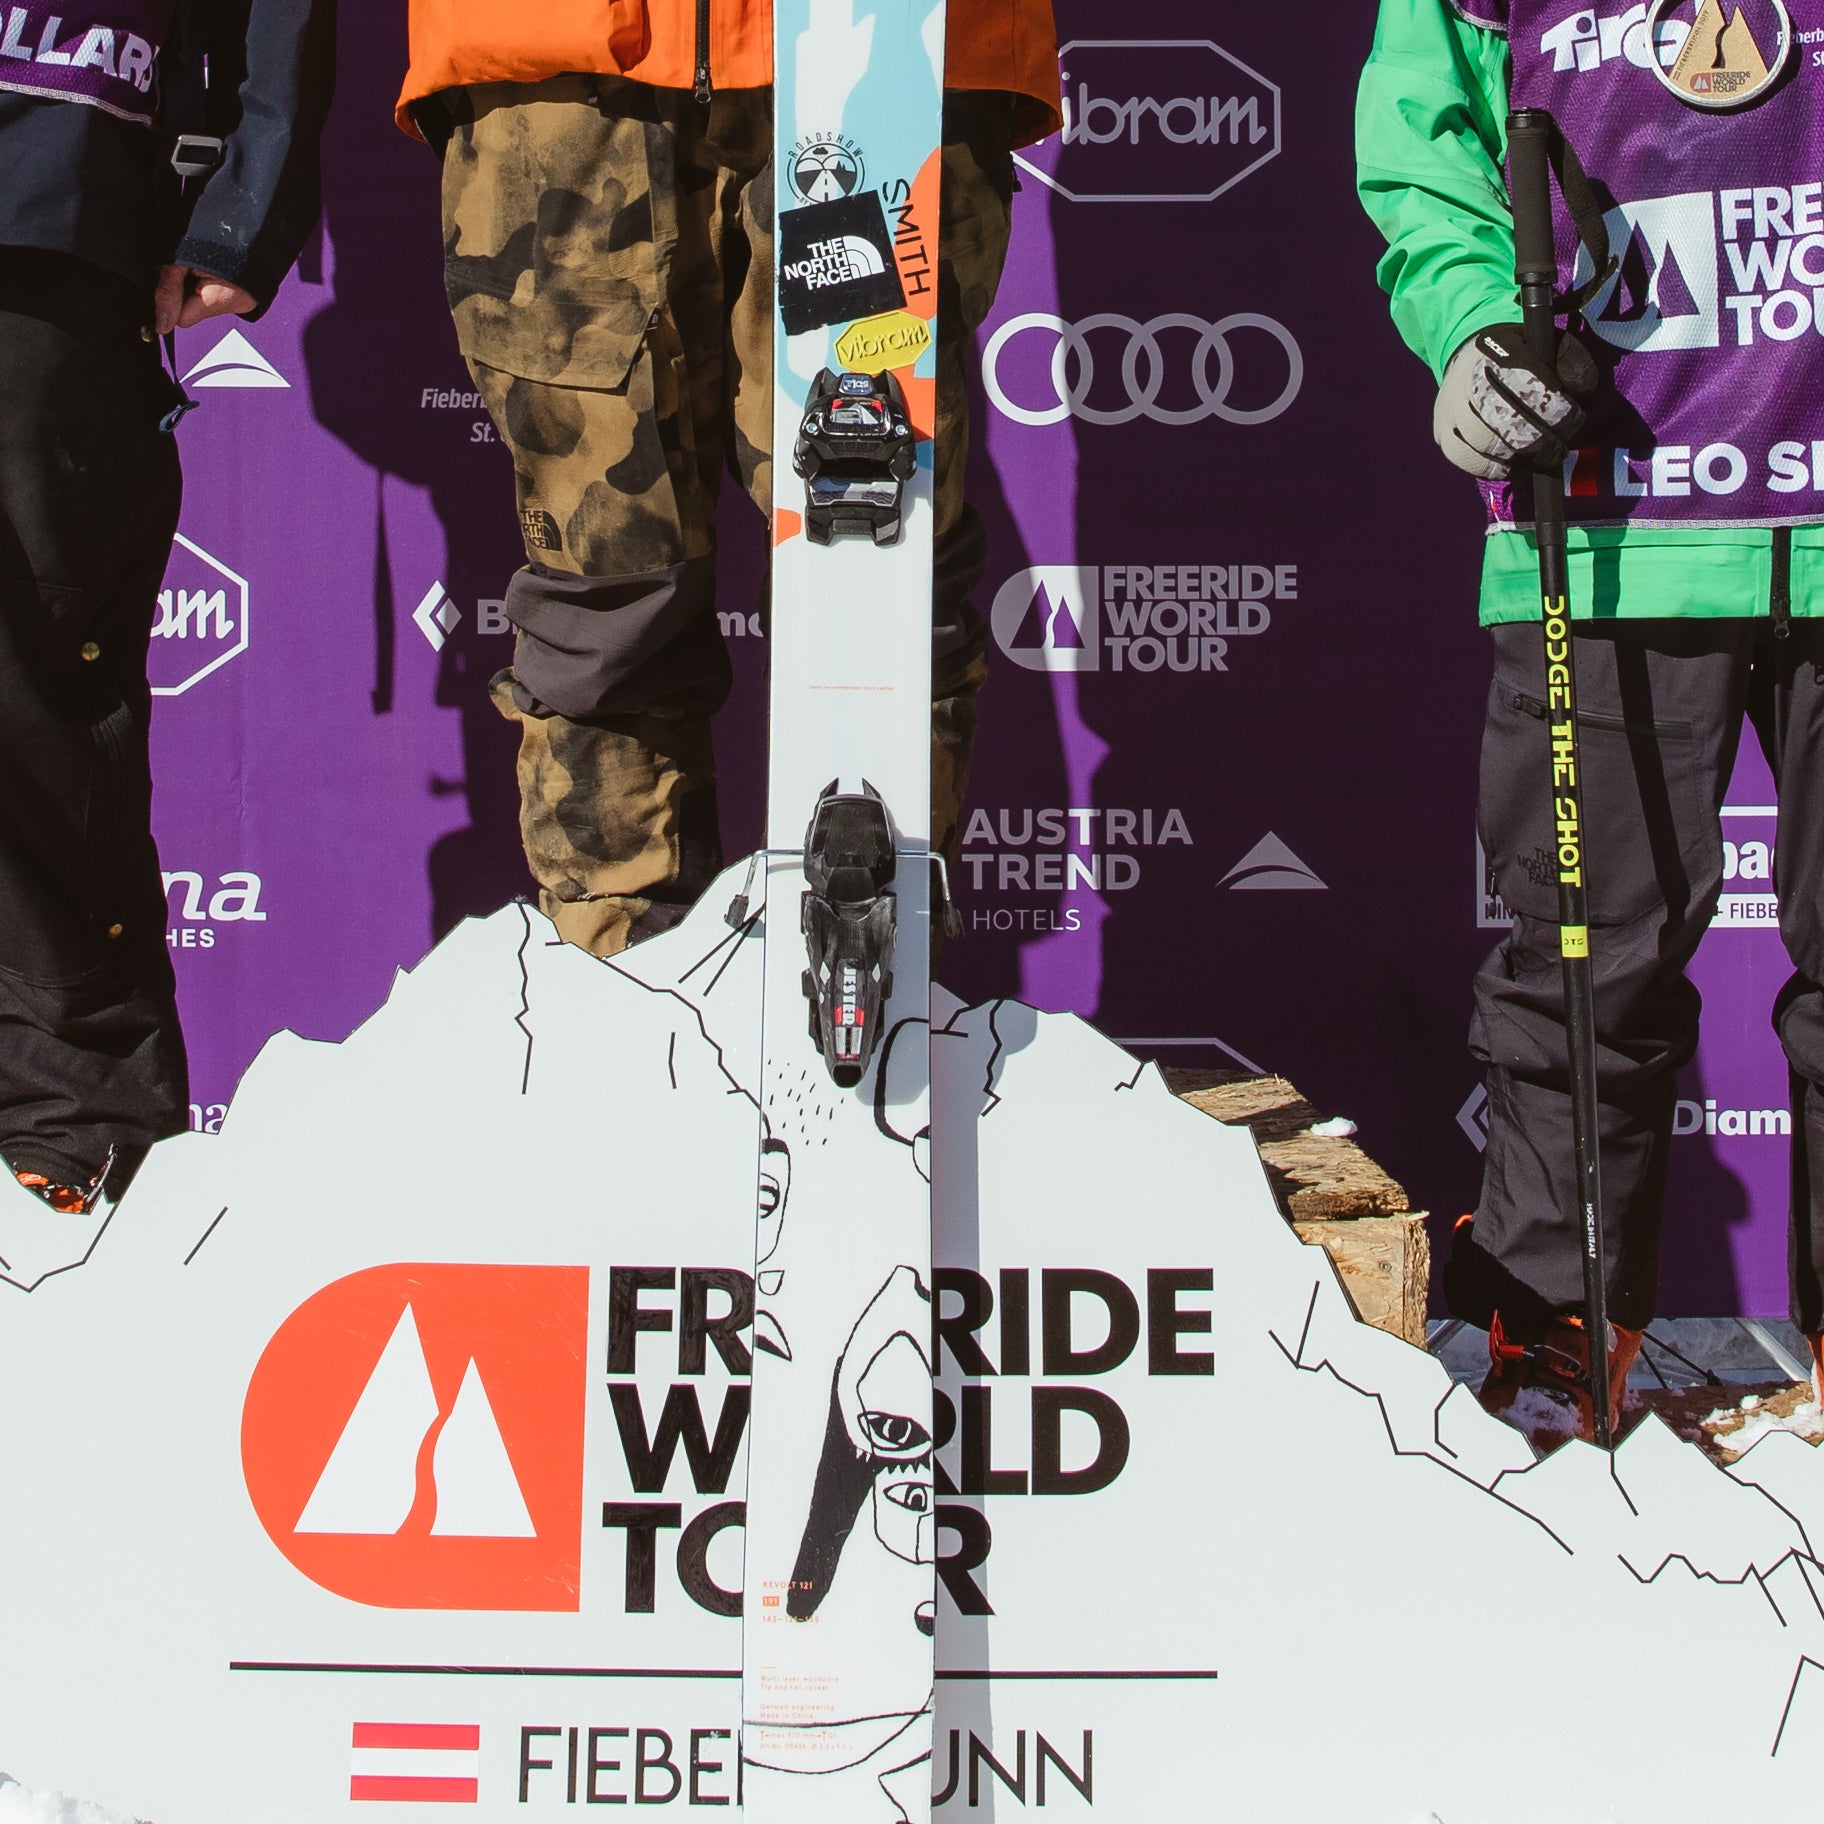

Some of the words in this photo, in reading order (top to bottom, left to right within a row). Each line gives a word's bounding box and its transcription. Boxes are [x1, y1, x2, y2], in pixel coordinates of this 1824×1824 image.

[787, 131, 866, 160] ROADSHOW
[807, 237, 845, 255] THE
[882, 178, 931, 296] SMITH
[783, 251, 849, 281] NORTH
[806, 266, 853, 290] FACE
[841, 322, 929, 364] vibram
[1614, 443, 1747, 497] LEO
[1104, 565, 1297, 599] FREERIDE
[1105, 601, 1270, 636] WORLD
[1105, 637, 1228, 672] TOUR
[1544, 595, 1571, 710] DODGE
[1551, 719, 1575, 787] THE
[1555, 797, 1581, 888] SHOT
[607, 1264, 1216, 1379] FRRIDE
